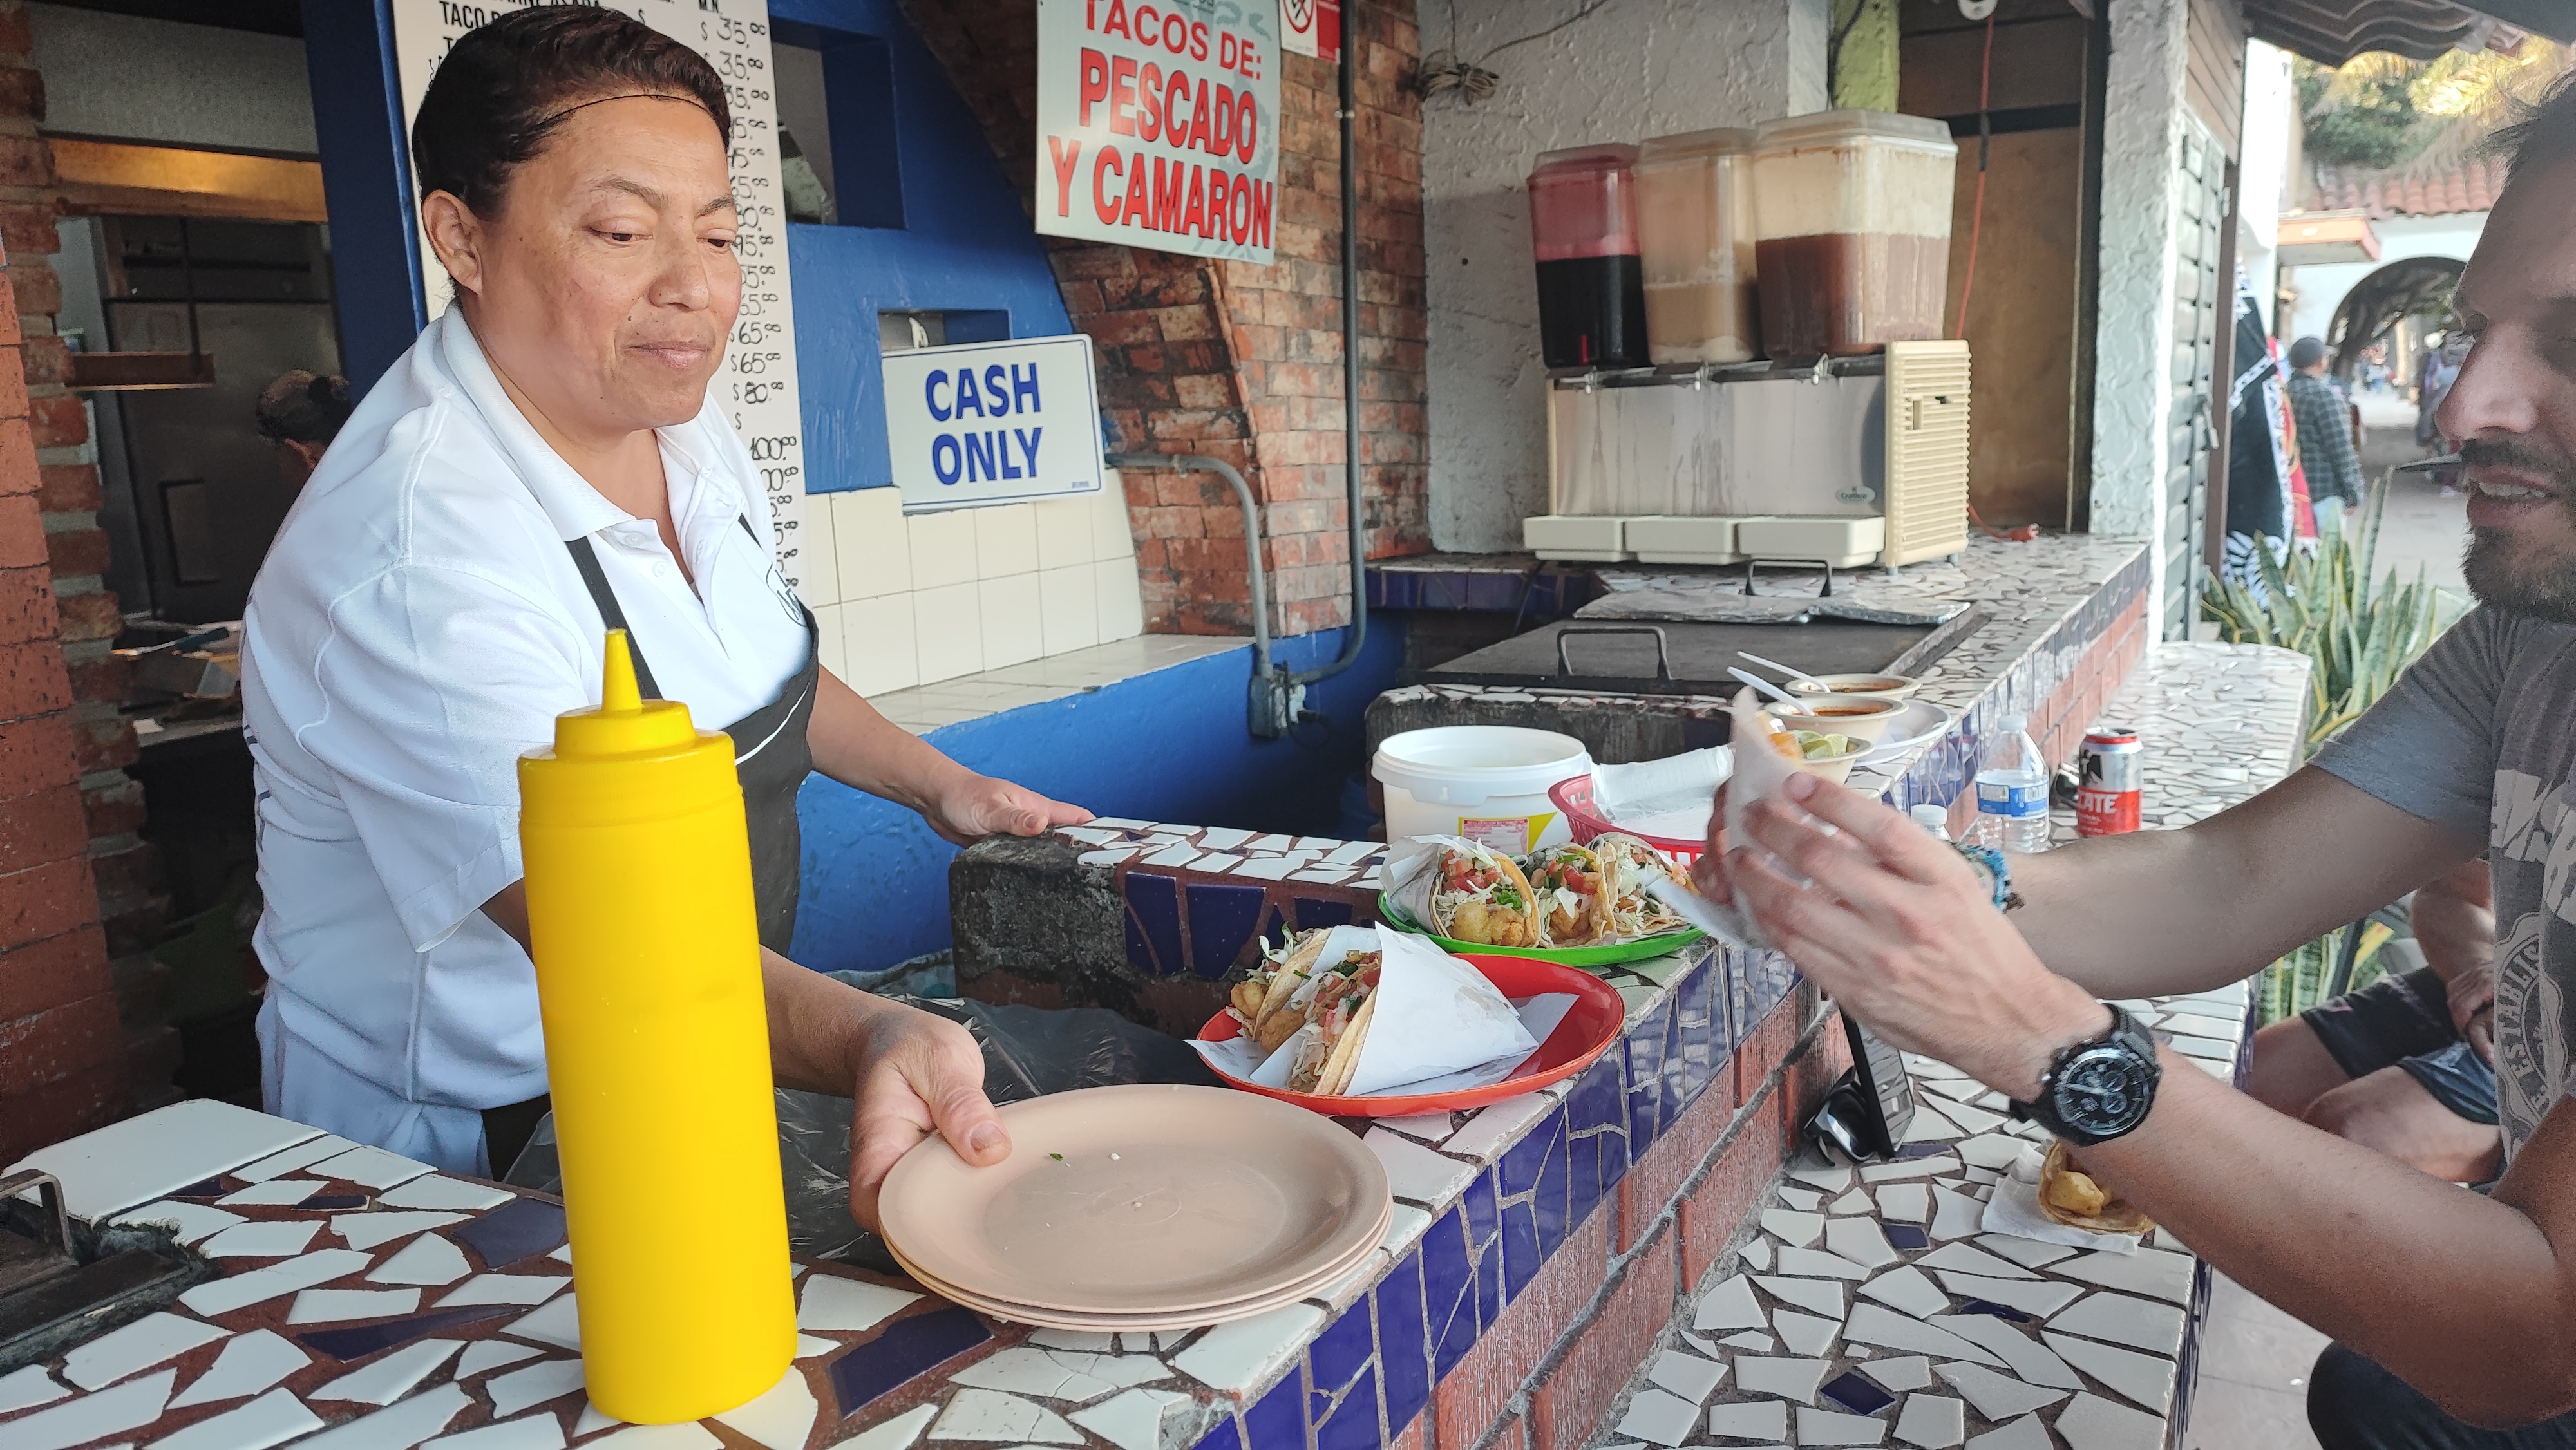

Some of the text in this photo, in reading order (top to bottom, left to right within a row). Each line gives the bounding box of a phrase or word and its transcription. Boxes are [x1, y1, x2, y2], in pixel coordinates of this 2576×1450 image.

[440, 1, 484, 29] TACO
[1220, 31, 1262, 80] DE:
[1079, 47, 1258, 165] PESCADO
[1048, 135, 1273, 249] Y CAMARON
[925, 362, 1041, 422] CASH
[933, 426, 1043, 485] ONLY
